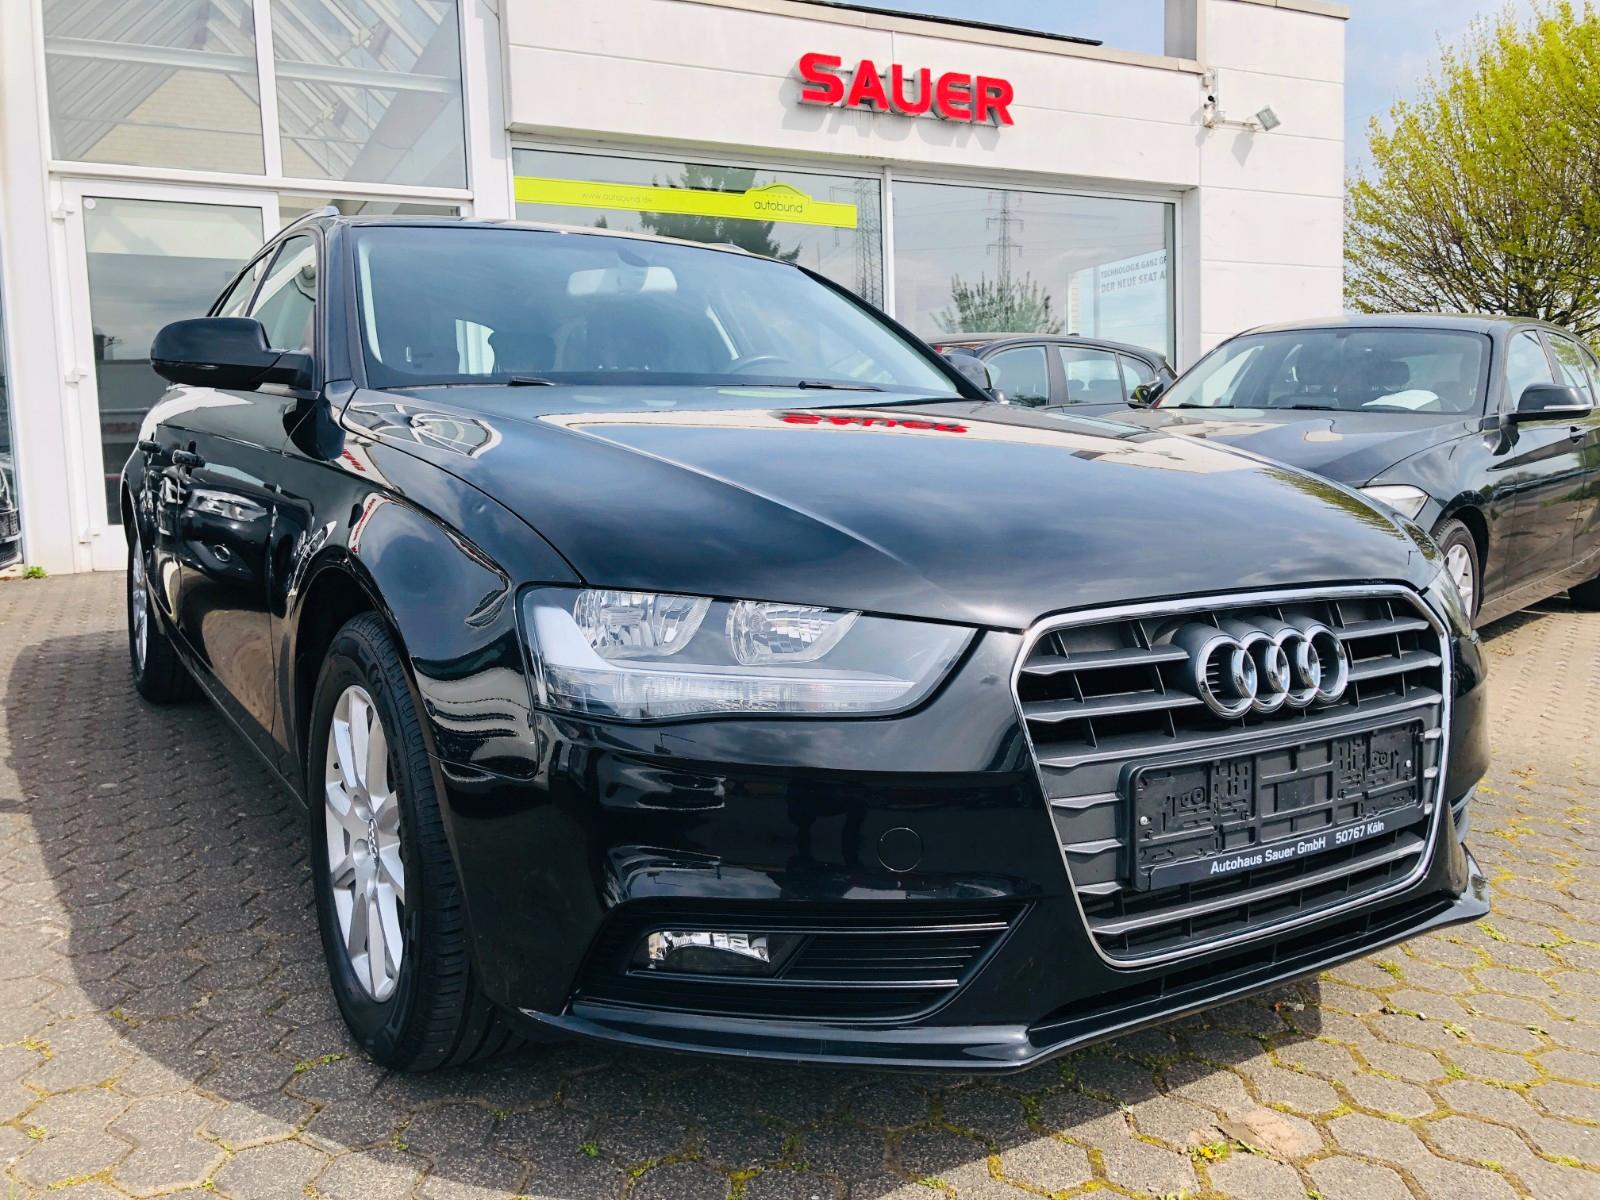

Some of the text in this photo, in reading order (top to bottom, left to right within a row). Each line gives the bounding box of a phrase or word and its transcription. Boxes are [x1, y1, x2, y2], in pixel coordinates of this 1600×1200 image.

[798, 52, 1015, 126] SAUER
[753, 199, 803, 214] autobund
[1101, 281, 1116, 294] DER
[1117, 276, 1137, 289] NEUE
[1138, 271, 1158, 284] SEAT
[1210, 820, 1385, 875] Autohaus Sauer GmbH 50767 Köln
